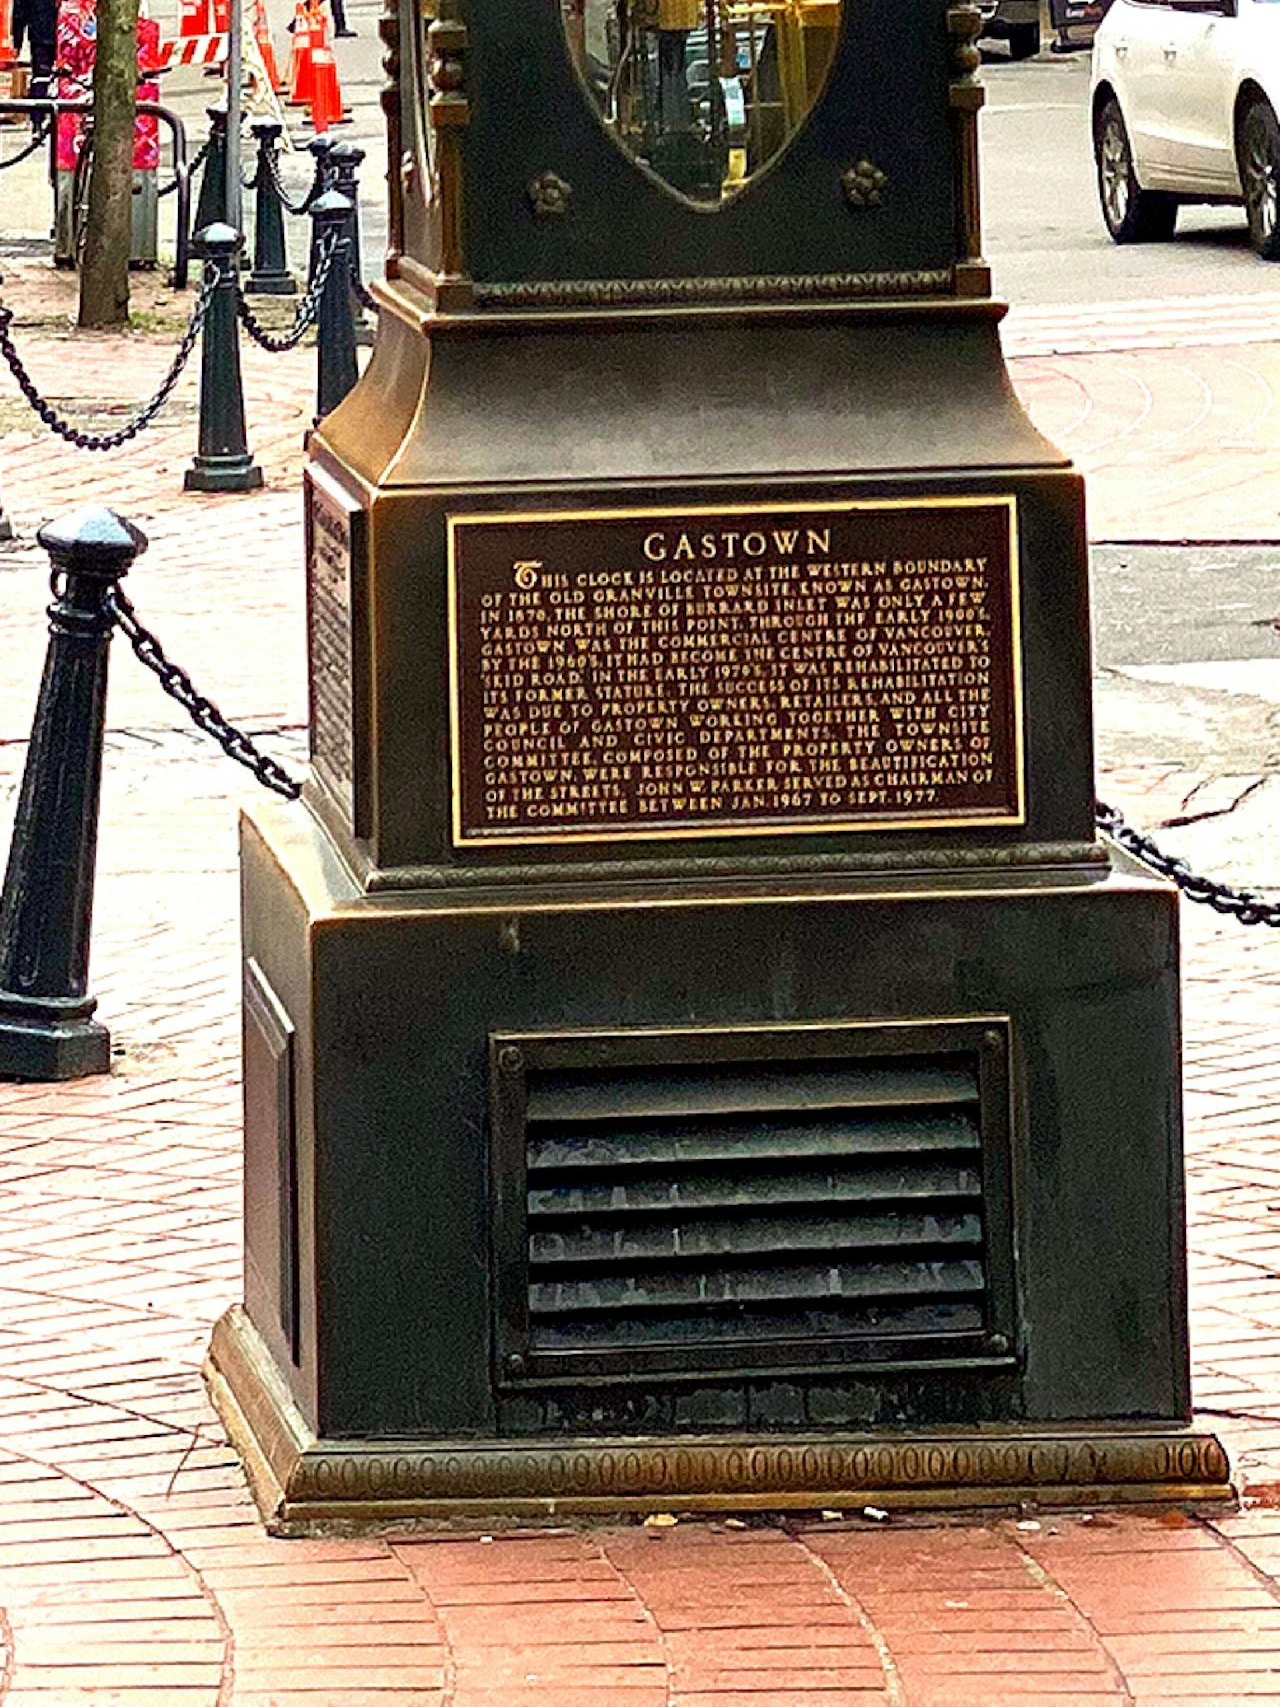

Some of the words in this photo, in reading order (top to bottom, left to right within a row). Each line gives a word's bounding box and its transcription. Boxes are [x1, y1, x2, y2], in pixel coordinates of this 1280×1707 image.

[643, 528, 832, 562] GASTOWN
[576, 571, 633, 587] CLOCK
[639, 570, 653, 583] IS
[660, 567, 738, 584] LOCATED
[742, 566, 762, 580] AT
[769, 565, 799, 579] THE
[806, 561, 886, 578] WESTERN
[892, 557, 987, 575] BOUNDARY
[480, 593, 502, 607] OF
[508, 591, 540, 606] THE
[549, 590, 585, 604] OLD
[592, 585, 693, 602] GRANVILLE
[799, 579, 866, 595] KNOWN
[873, 578, 892, 592] AS
[480, 609, 500, 623] IN
[554, 606, 585, 620] THE
[594, 604, 651, 619] SHORE
[657, 602, 679, 616] OF
[685, 599, 768, 615] BURRARD
[775, 597, 827, 612] INLET
[835, 595, 870, 610] WAS
[877, 593, 924, 608] ONLY
[931, 594, 943, 606] A
[948, 591, 985, 606] FEW
[479, 624, 538, 639] YARDS
[546, 622, 606, 637] NORTH
[612, 620, 633, 634] OF
[641, 619, 678, 633] THIS
[749, 613, 828, 629] THROUGH
[836, 612, 865, 625] THE
[874, 608, 931, 625] EARLY
[480, 639, 565, 656] GASTOWN
[574, 637, 611, 652] WAS
[619, 636, 648, 650] THE
[657, 631, 769, 649] COMMERCIAL
[776, 628, 846, 643] CENTRE
[855, 627, 877, 641] OF
[481, 658, 502, 671] BY
[508, 655, 538, 670] THE
[606, 653, 622, 667] IT
[626, 651, 664, 666] HAD
[670, 648, 736, 664] BECOME
[744, 647, 774, 660] THE
[779, 644, 845, 660] CENTRE
[852, 644, 873, 657] OF
[592, 670, 611, 682] IN
[616, 668, 646, 682] THE
[654, 666, 709, 681] EARLY
[771, 663, 787, 676] IT
[793, 661, 826, 674] WAS
[832, 656, 963, 674] REHABILITATED
[969, 654, 990, 669] TO
[483, 690, 507, 704] ITS
[515, 686, 587, 702] FORMER
[679, 681, 708, 696] THE
[717, 679, 785, 694] SUCCESS
[789, 678, 809, 691] OF
[815, 677, 840, 690] ITS
[847, 671, 989, 690] REHABILITATION
[483, 705, 520, 720] WAS
[528, 704, 561, 719] DUE
[570, 703, 593, 717] TO
[601, 699, 689, 716] PROPERTY
[880, 691, 916, 705] AND
[921, 689, 953, 703] ALL
[958, 688, 990, 701] THE
[483, 721, 549, 737] PEOPLE
[558, 720, 579, 733] OF
[590, 716, 677, 733] GASTOWN
[689, 711, 777, 728] WORKING
[788, 708, 880, 725] TOGETHER
[889, 705, 936, 720] WITH
[947, 703, 989, 719] CITY
[483, 736, 565, 752] COUNCIL
[578, 734, 618, 748] AND
[633, 731, 684, 746] CIVIC
[846, 724, 880, 738] THE
[895, 719, 989, 736] TOWNSITE
[602, 747, 697, 764] COMPOSED
[707, 746, 729, 759] OF
[737, 744, 768, 758] THE
[782, 740, 875, 757] PROPERTY
[885, 736, 962, 753] OWNERS
[969, 735, 989, 749] OF
[582, 766, 630, 781] WERE
[641, 761, 755, 778] RESPONSIBLE
[765, 758, 802, 773] FOR
[809, 757, 841, 772] THE
[849, 751, 992, 772] BEAUTIFICATION
[485, 789, 505, 802] OF
[512, 786, 543, 800] THE
[635, 781, 683, 796] JOHN
[710, 777, 778, 793] PARKER
[783, 774, 847, 790] SERVED
[850, 774, 869, 787] AS
[873, 769, 968, 787] CHAIRMAN
[971, 768, 992, 783] OF
[486, 804, 517, 819] THE
[526, 799, 627, 817] COMMITTEE
[639, 795, 722, 812] BETWEEN
[773, 792, 811, 807] 1967
[819, 791, 841, 805] TO
